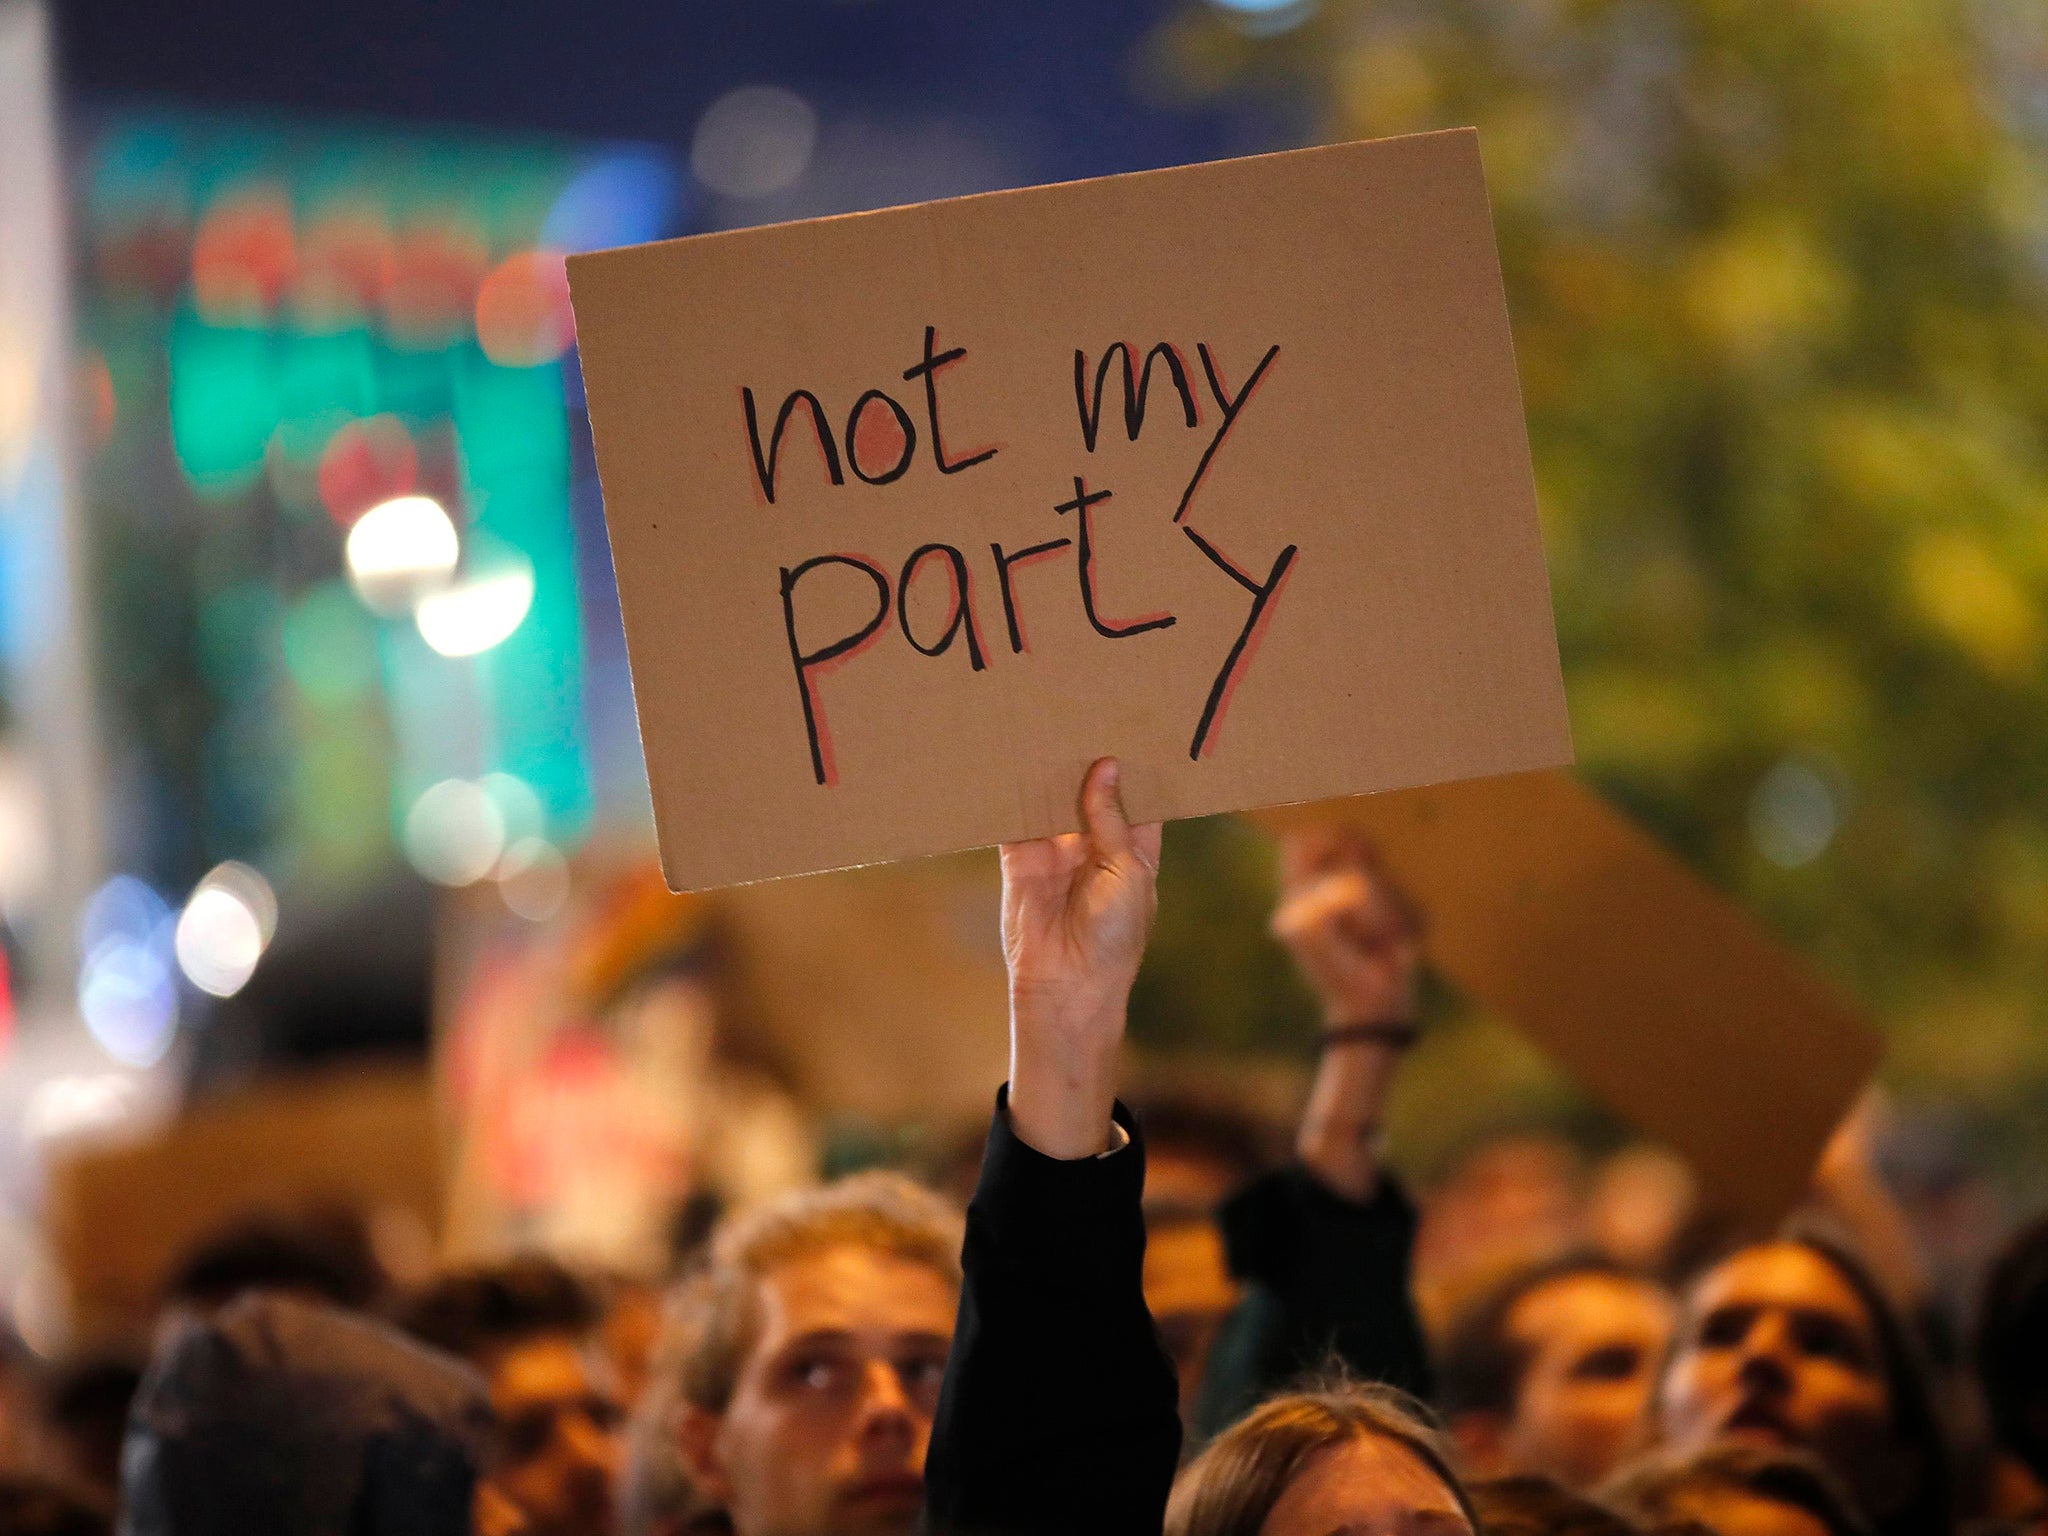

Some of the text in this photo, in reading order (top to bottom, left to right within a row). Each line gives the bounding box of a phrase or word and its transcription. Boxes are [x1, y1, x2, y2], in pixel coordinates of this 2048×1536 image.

[740, 325, 1281, 524] not my
[779, 476, 1299, 786] party
